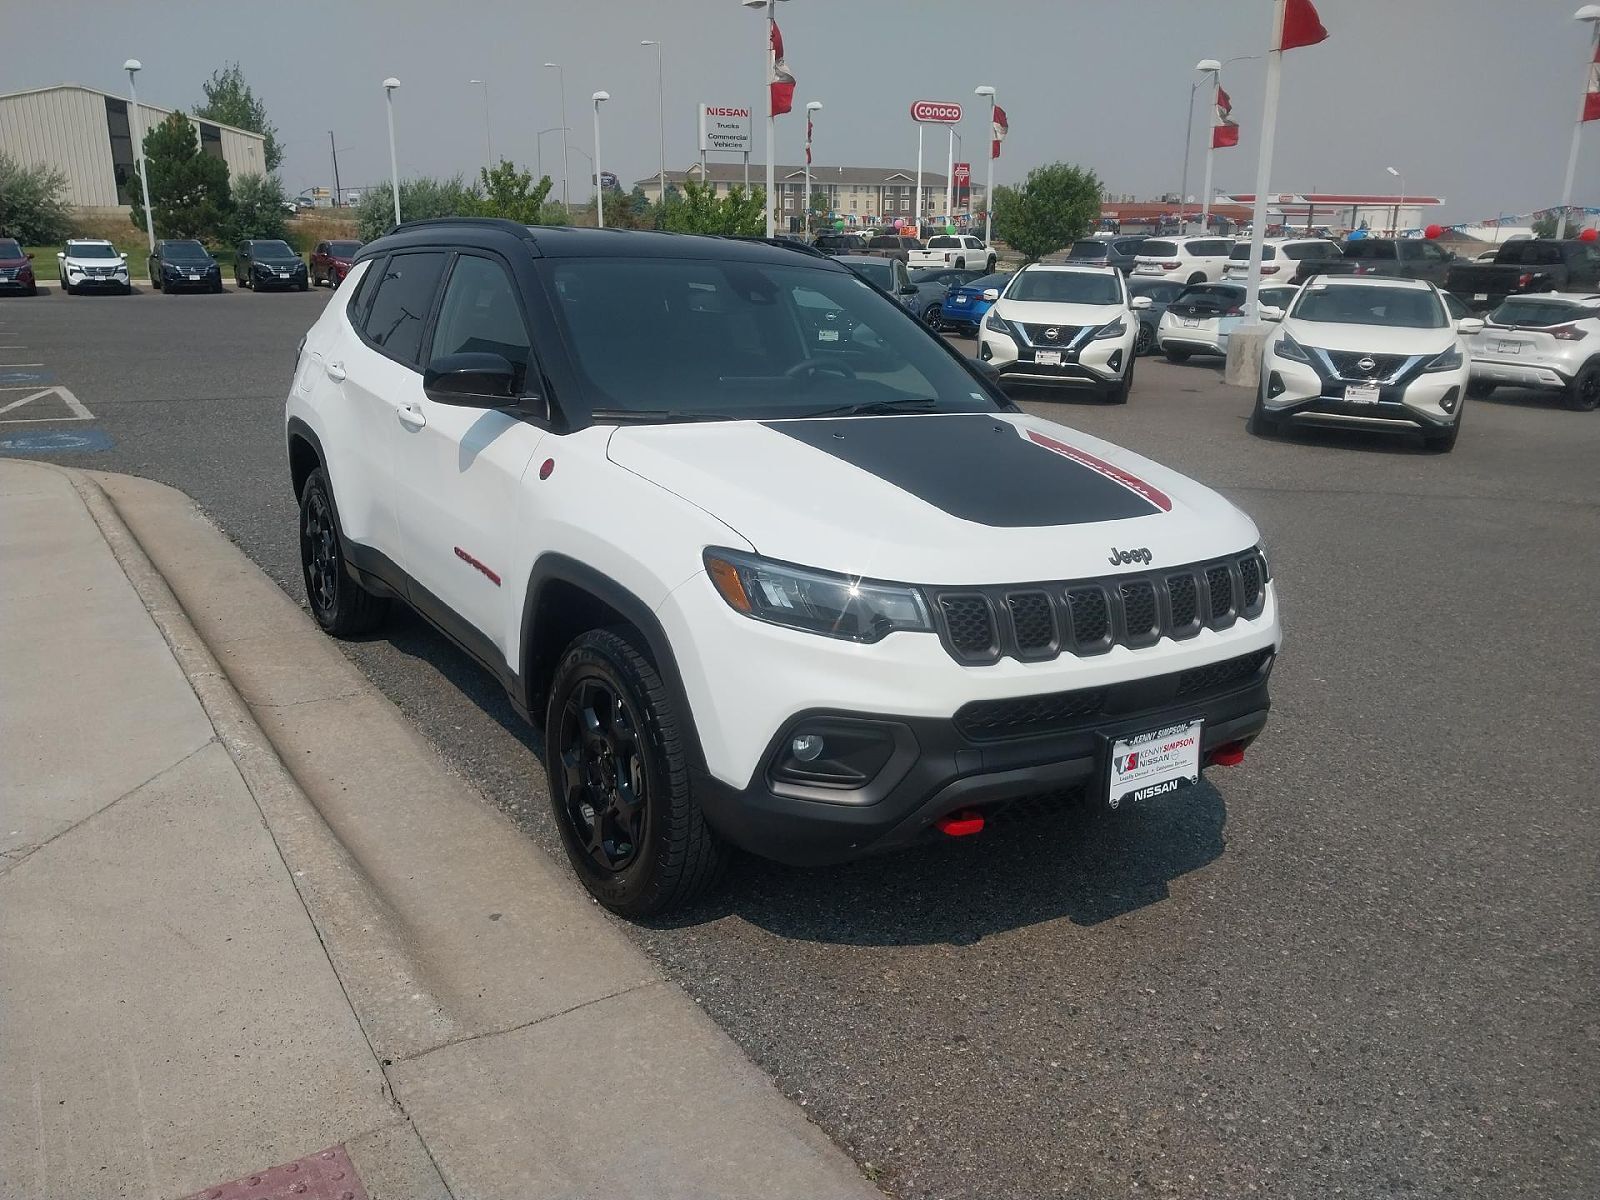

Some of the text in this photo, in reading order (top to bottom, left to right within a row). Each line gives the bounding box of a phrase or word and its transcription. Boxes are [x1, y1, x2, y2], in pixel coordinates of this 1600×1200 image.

[706, 107, 748, 117] NISSAN
[707, 133, 748, 141] Commercial
[1108, 547, 1153, 566] Jeep
[1133, 723, 1187, 745] KENNY SIMPSON
[1139, 753, 1170, 768] NISSAN
[1134, 780, 1178, 801] NISSAN
